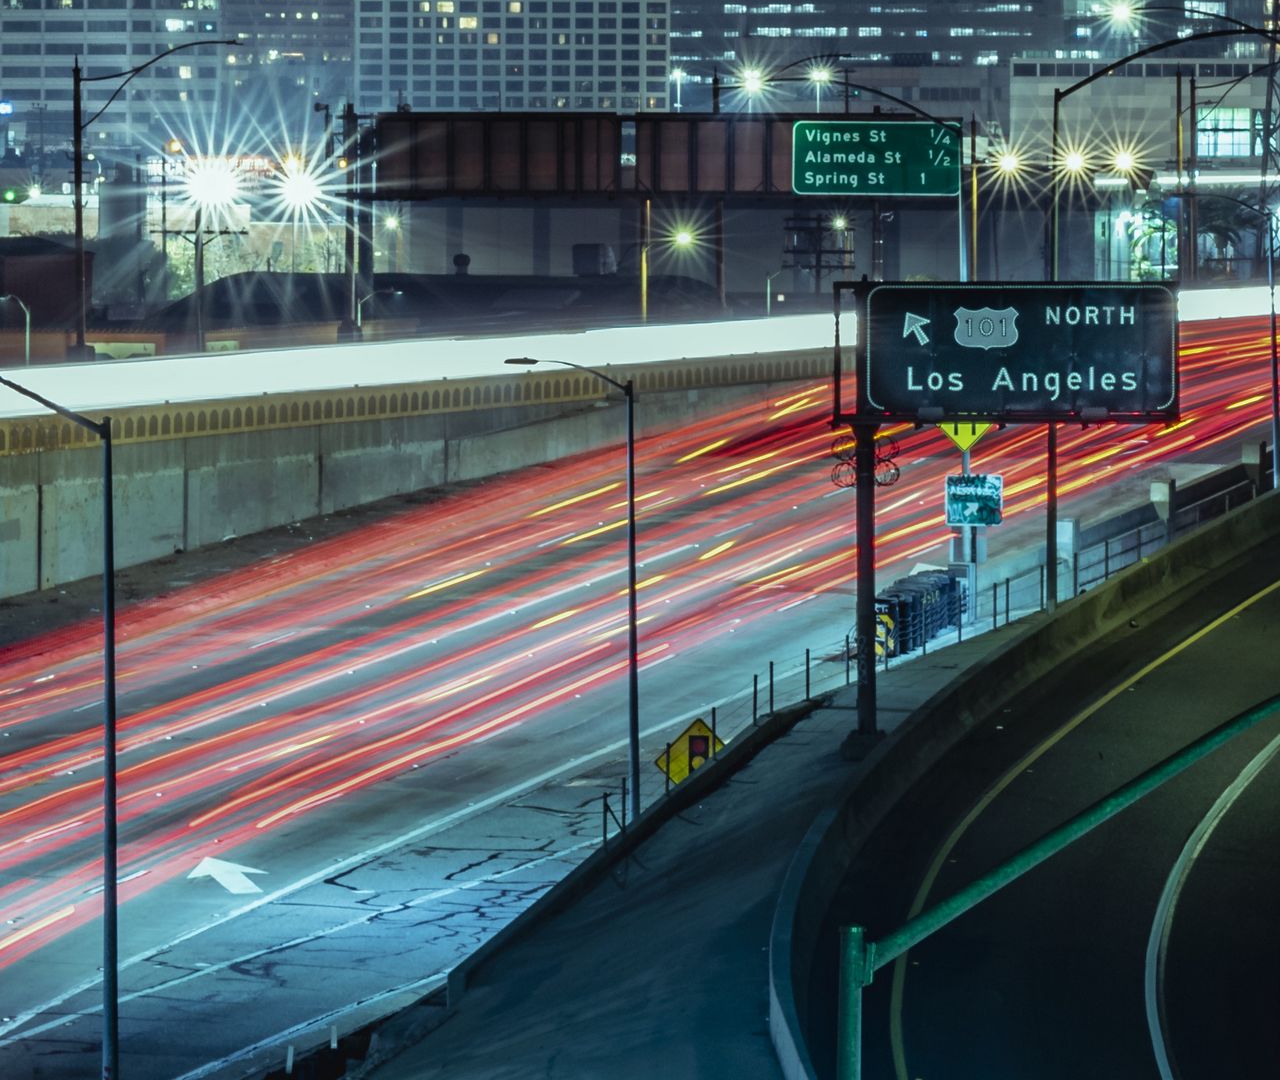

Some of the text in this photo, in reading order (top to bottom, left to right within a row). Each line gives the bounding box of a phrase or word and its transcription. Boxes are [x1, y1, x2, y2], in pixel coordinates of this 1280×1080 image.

[805, 129, 860, 146] Vignes
[869, 130, 886, 142] St
[805, 150, 875, 164] Alameda
[884, 151, 901, 164] St
[804, 171, 926, 188] Spring St 1
[1045, 306, 1135, 326] NORTH
[964, 317, 1008, 337] 101
[907, 366, 1138, 401] Los Angeles
